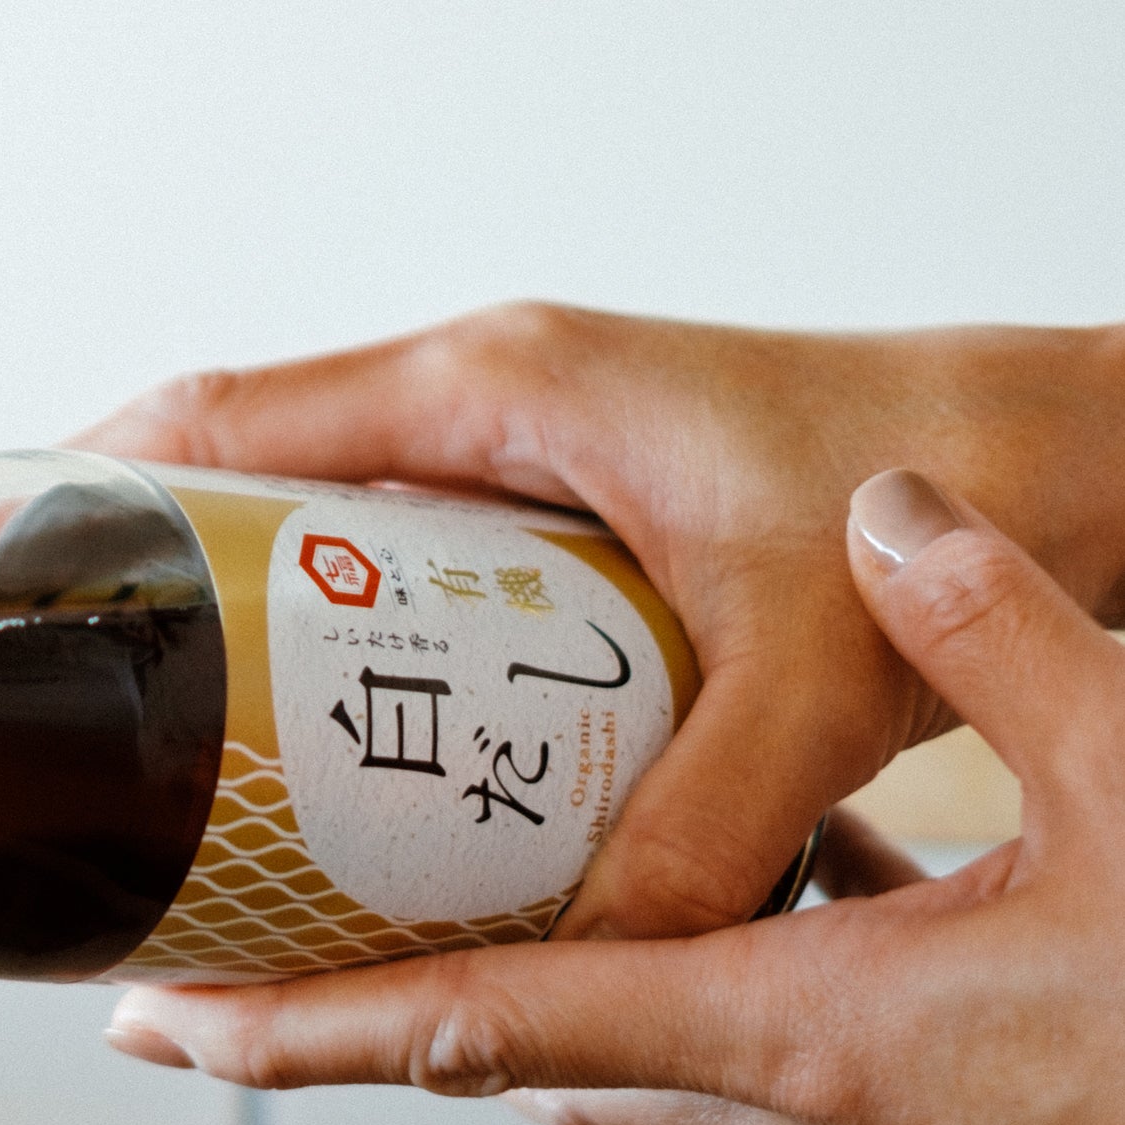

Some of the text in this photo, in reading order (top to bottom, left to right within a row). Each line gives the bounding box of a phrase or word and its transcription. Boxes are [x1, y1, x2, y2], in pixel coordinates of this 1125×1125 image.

[322, 554, 360, 586] 七福
[380, 548, 408, 606] 味と心
[427, 558, 555, 620] 有機
[323, 626, 449, 654] しいたけ香る
[570, 707, 592, 807] Organic
[587, 710, 616, 843] Shirodashi
